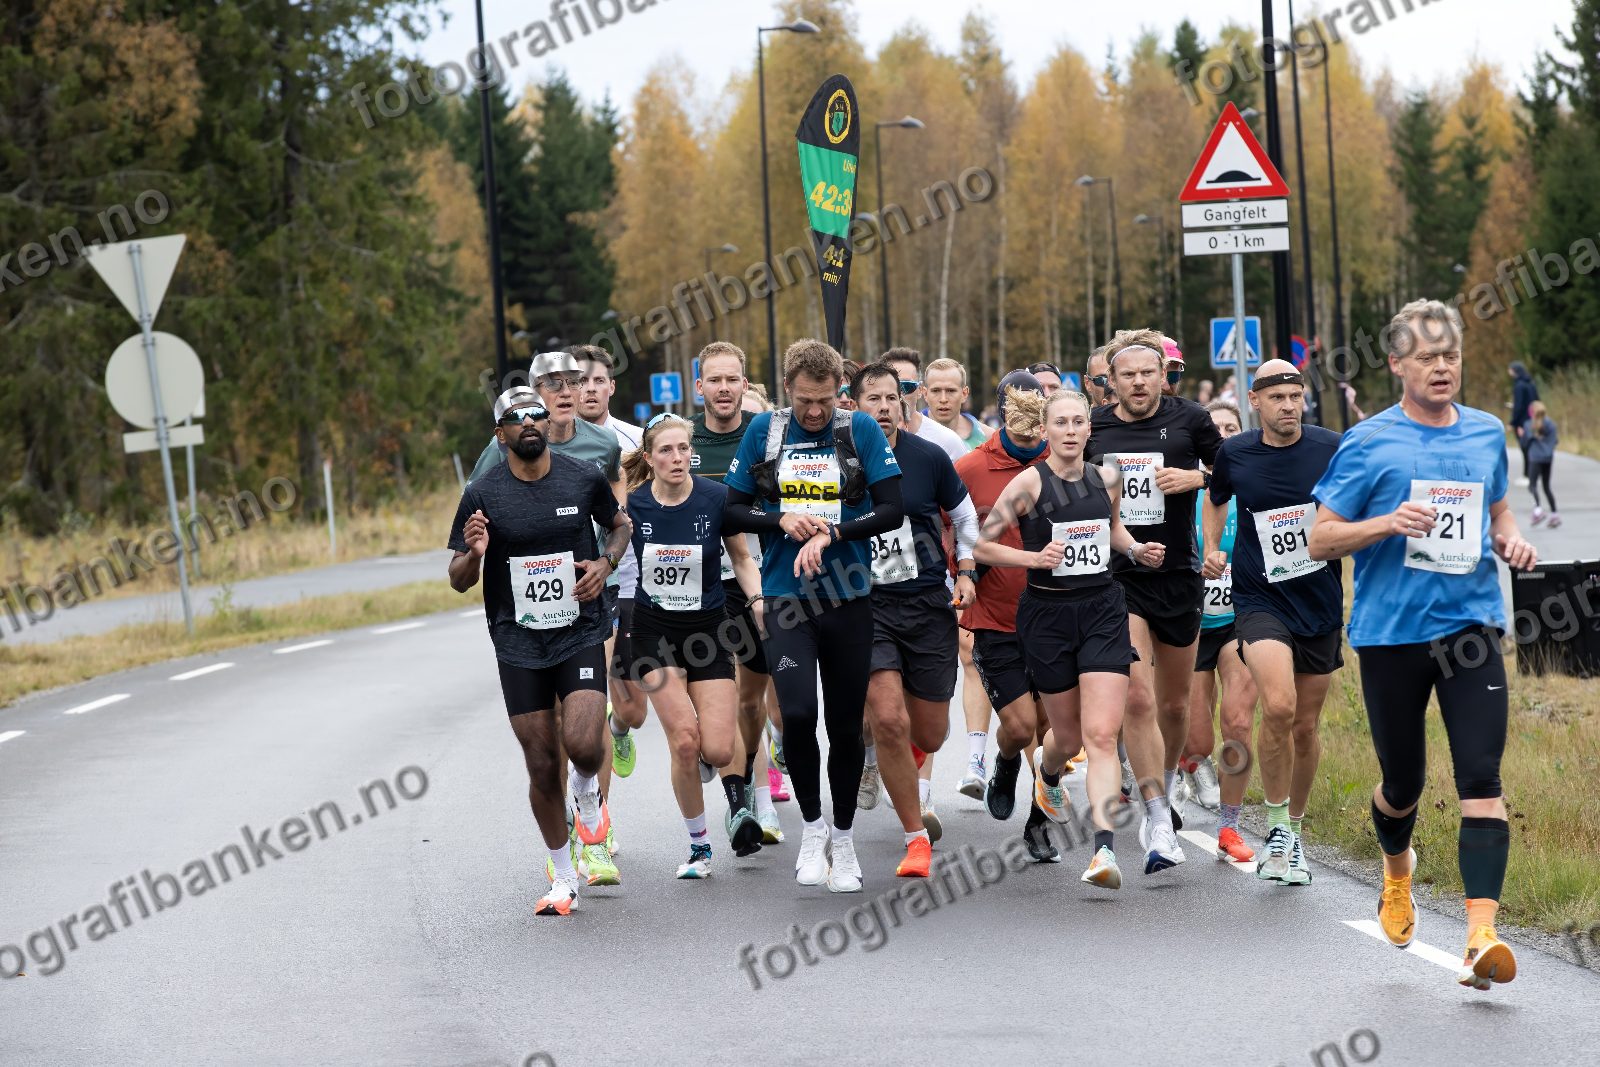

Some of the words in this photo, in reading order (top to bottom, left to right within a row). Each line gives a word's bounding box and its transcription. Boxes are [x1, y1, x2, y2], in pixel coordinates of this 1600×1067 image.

[810, 180, 853, 217] 42:3
[1204, 205, 1267, 223] Gangfelt
[1208, 236, 1218, 249] 0
[792, 463, 829, 471] NORGES
[1116, 457, 1153, 465] NORGES
[785, 483, 835, 501] PACE
[1427, 487, 1472, 498] NORGES
[1431, 496, 1465, 505] LØPET
[1129, 508, 1162, 518] Aurskog
[1269, 509, 1305, 522] NORGES
[1272, 517, 1301, 529] LØPET
[1066, 525, 1101, 534] NORGES
[1068, 532, 1097, 540] LØPET
[1271, 528, 1309, 556] 891
[1064, 544, 1101, 567] 943
[1439, 551, 1479, 564] Aurskog
[523, 558, 563, 569] NORGES
[527, 566, 557, 576] LØPET
[653, 566, 691, 586] 397
[525, 578, 564, 602] 429
[666, 594, 700, 604] Aurskog
[541, 609, 577, 621] Aurskog
